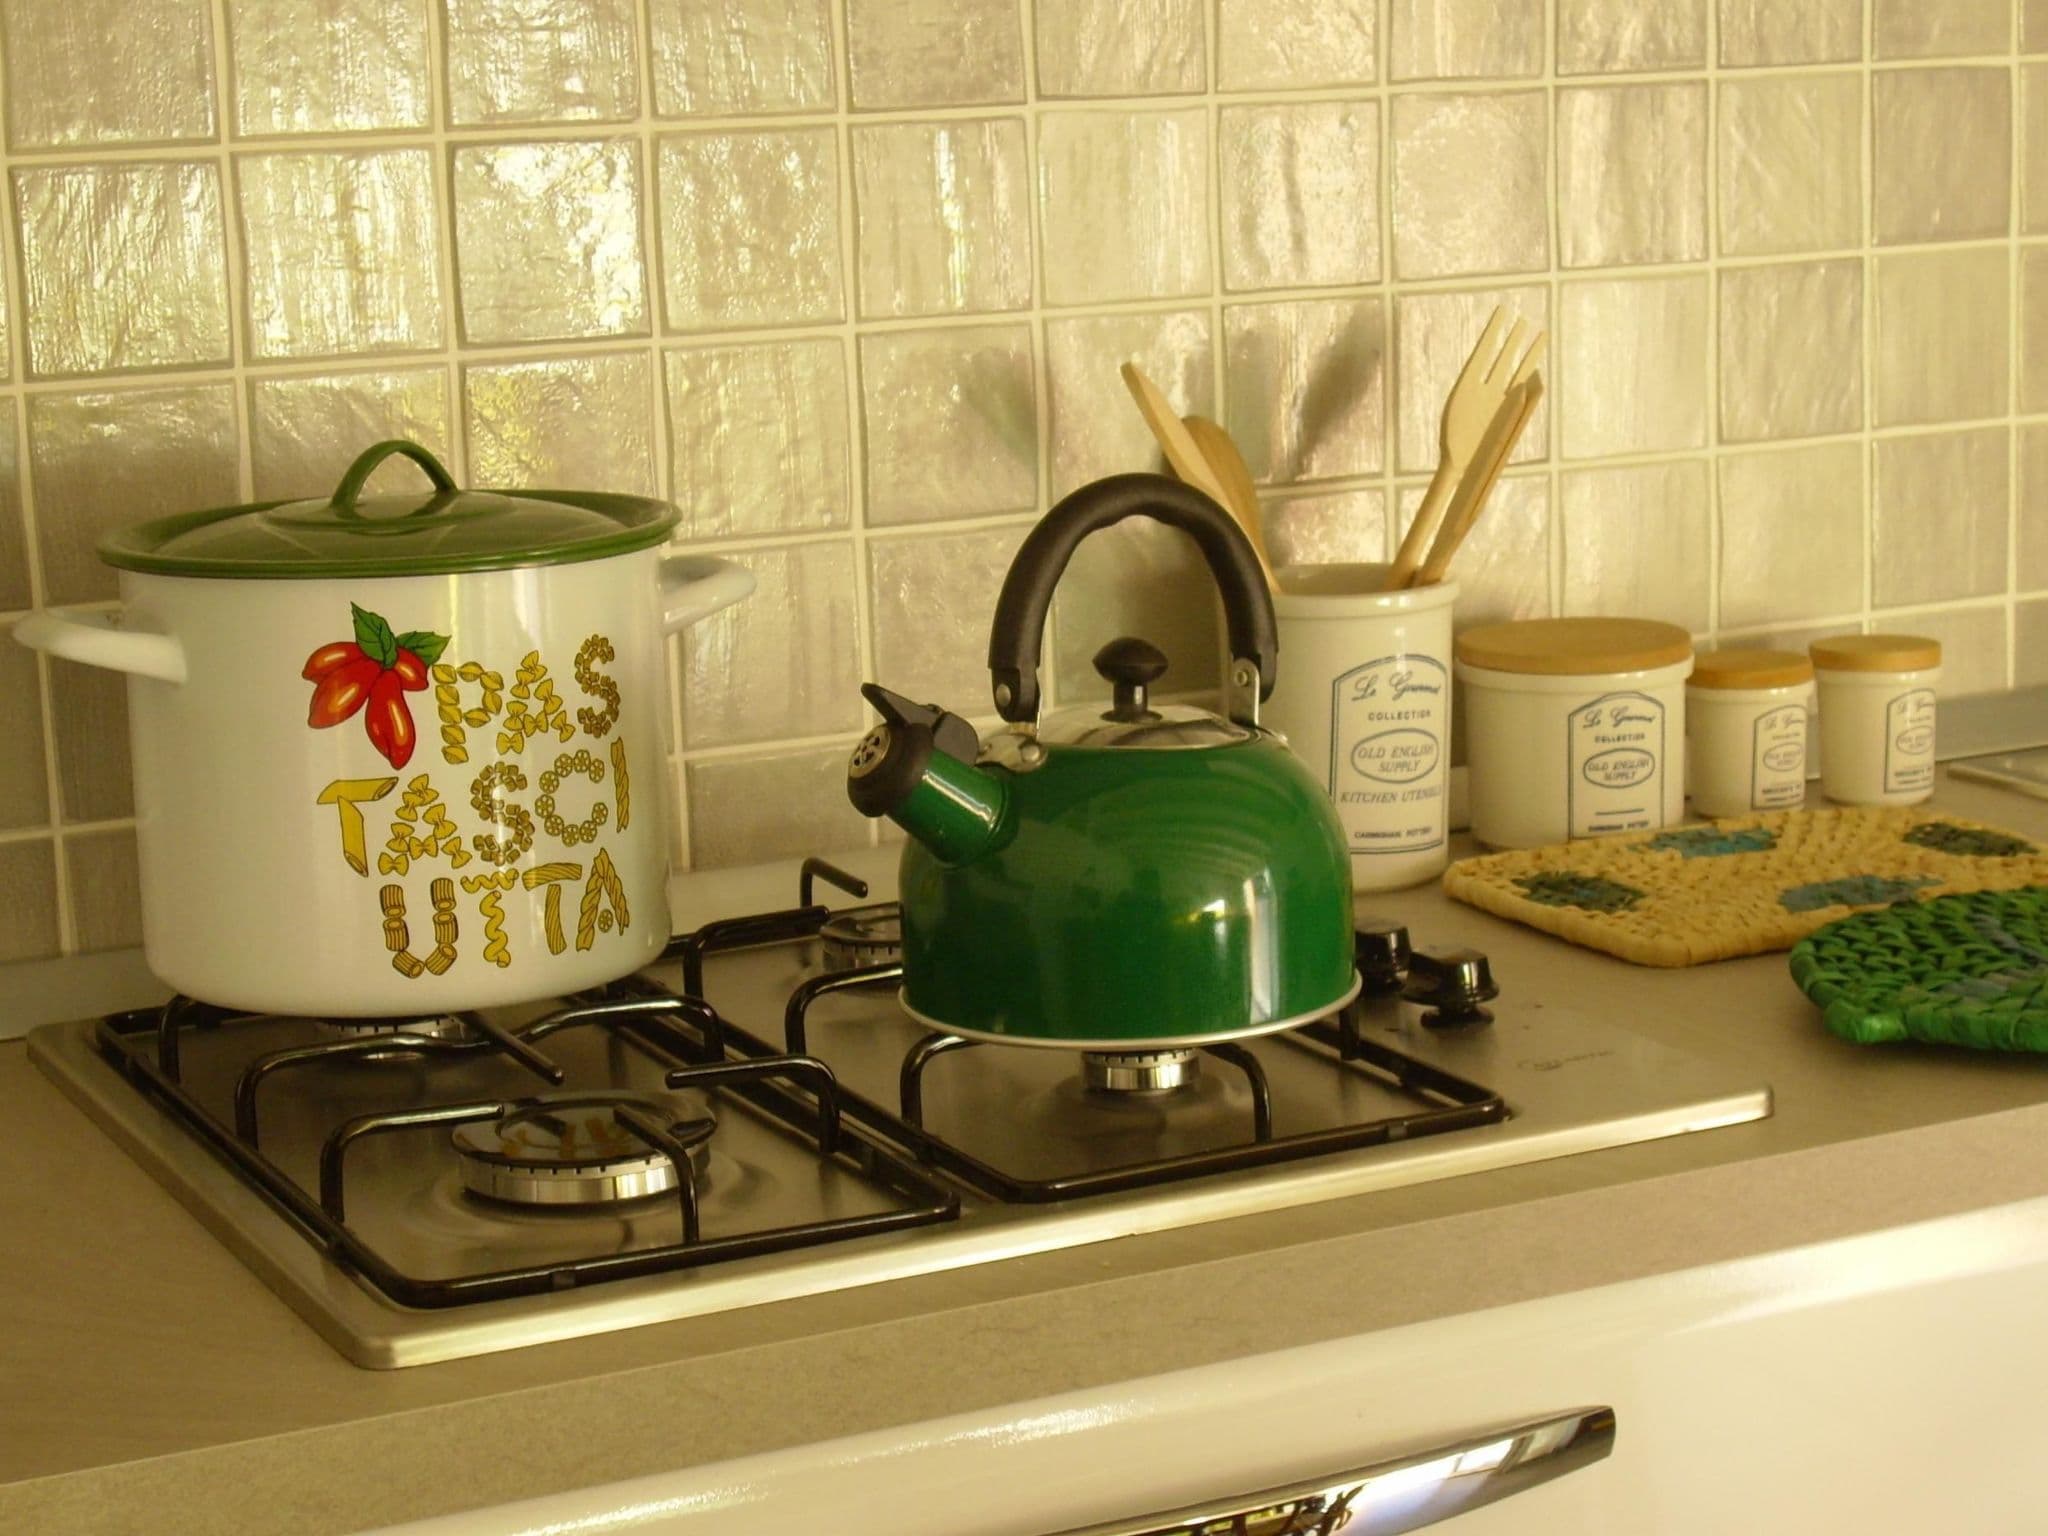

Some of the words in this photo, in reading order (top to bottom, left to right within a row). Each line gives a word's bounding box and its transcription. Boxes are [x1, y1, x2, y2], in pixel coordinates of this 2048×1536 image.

[1351, 674, 1378, 702] Le
[1368, 709, 1432, 722] COLLECTION
[1358, 747, 1386, 760] OLD
[1391, 743, 1434, 759] ENGLISH
[1379, 759, 1421, 773] SUPPLY
[1340, 790, 1397, 804] KITCHEN
[380, 848, 629, 978] UTTA
